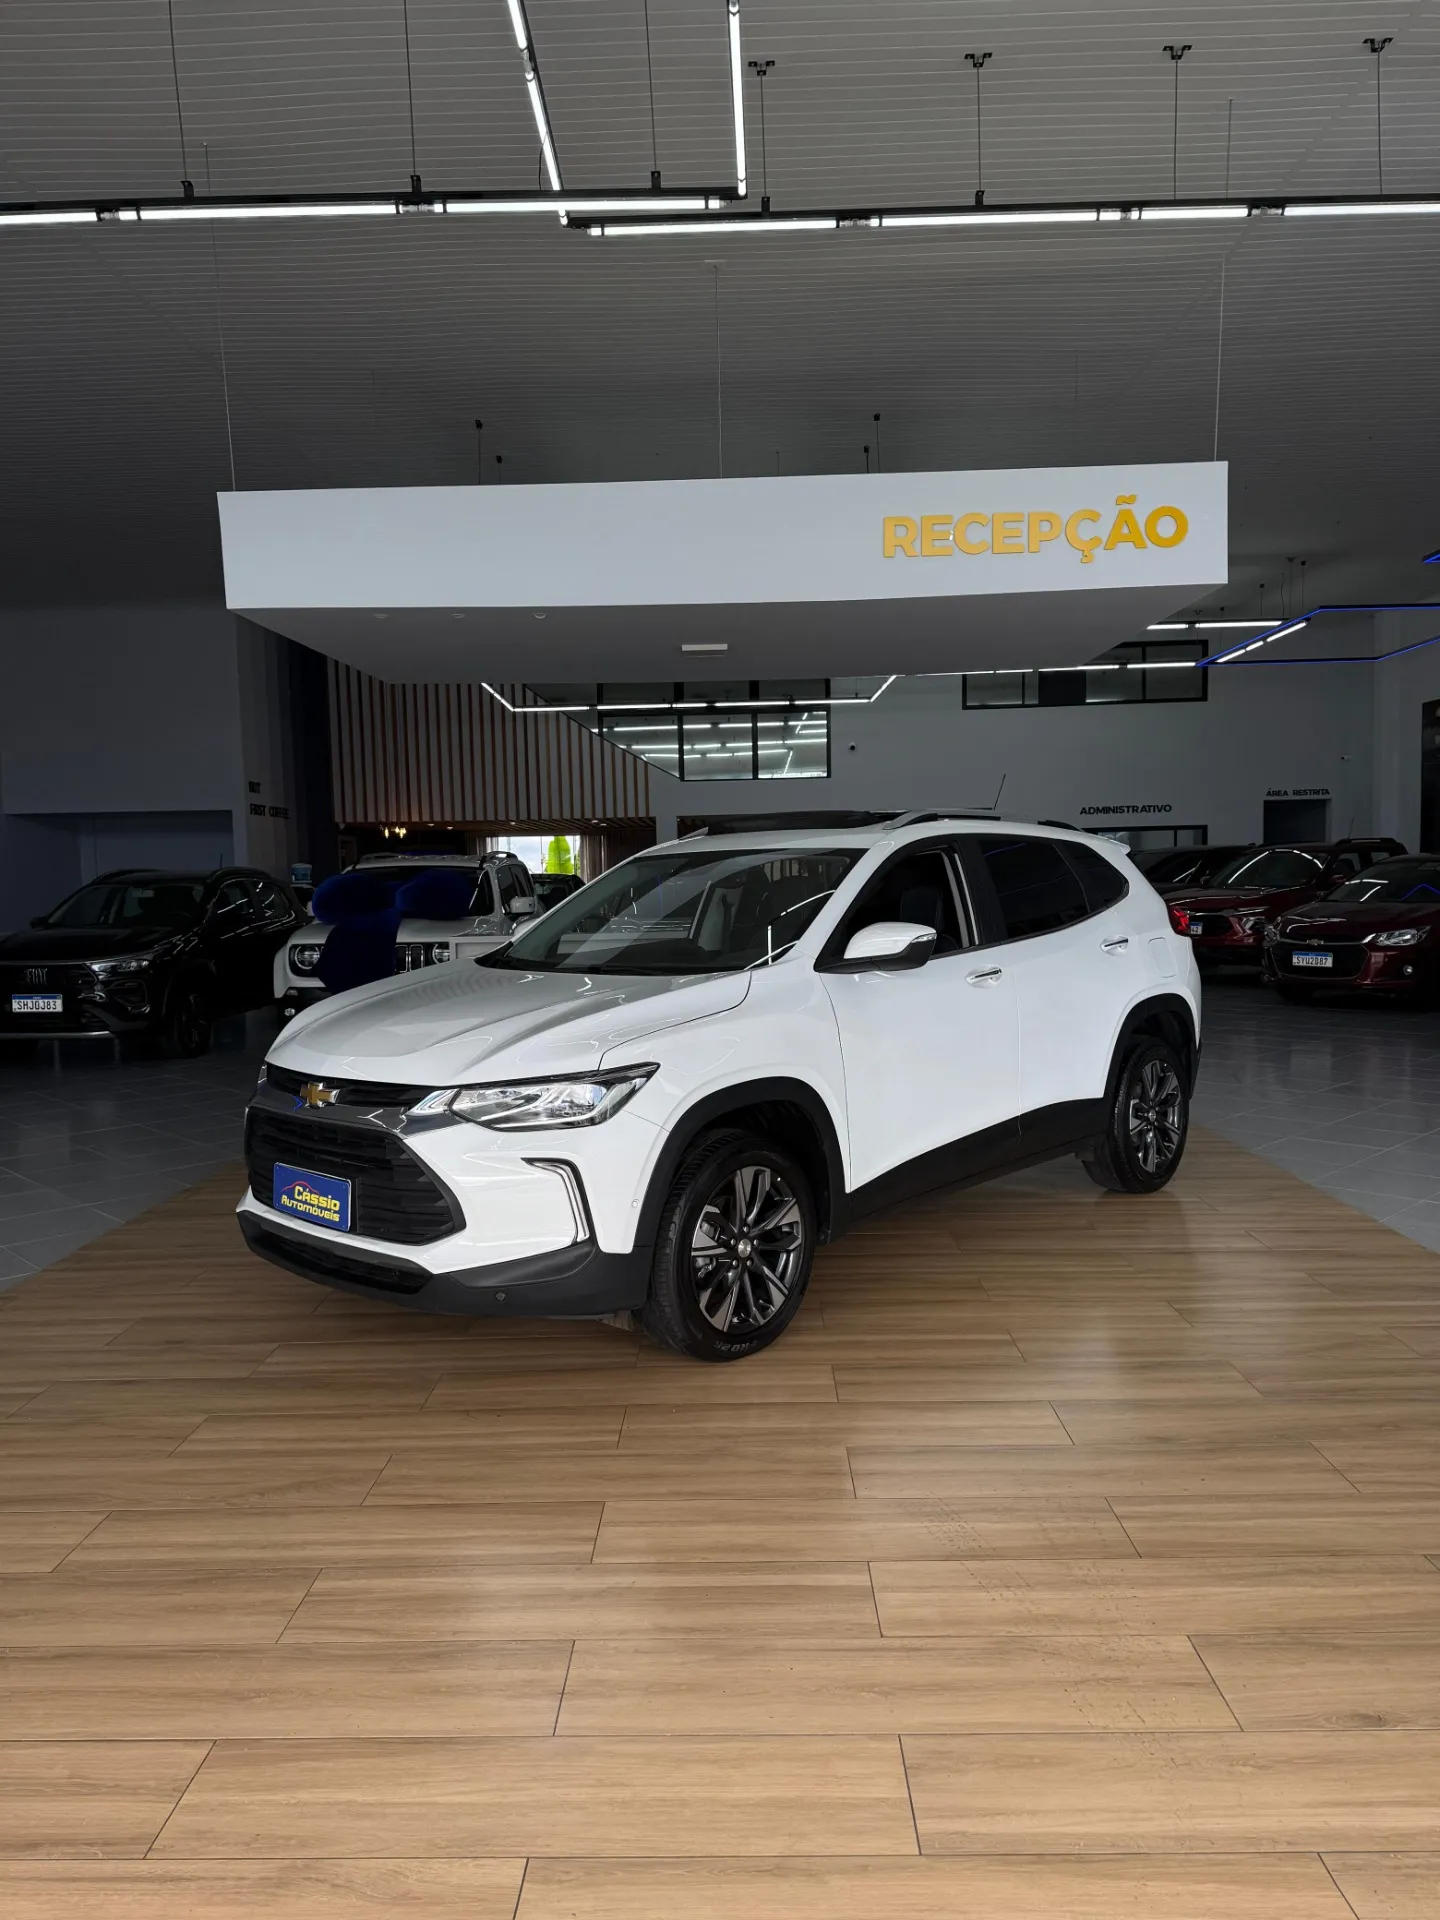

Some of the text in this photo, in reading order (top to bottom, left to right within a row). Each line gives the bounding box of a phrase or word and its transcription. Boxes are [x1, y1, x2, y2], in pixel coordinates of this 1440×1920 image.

[883, 494, 1189, 563] RECEPÇÃO
[1266, 788, 1330, 797] ÁREA RESTRITA
[1079, 804, 1172, 815] ADMINISTRATIVO
